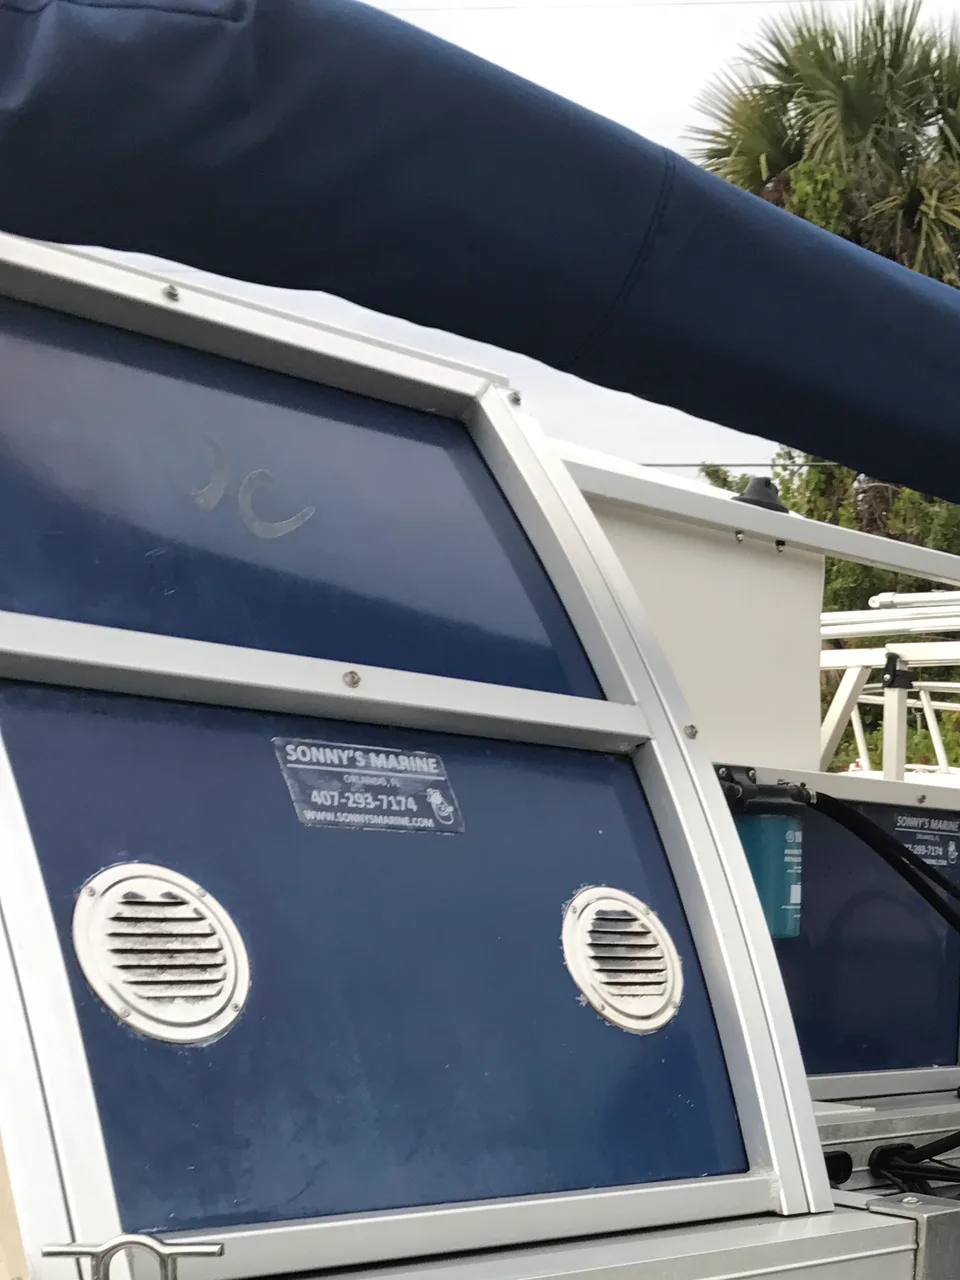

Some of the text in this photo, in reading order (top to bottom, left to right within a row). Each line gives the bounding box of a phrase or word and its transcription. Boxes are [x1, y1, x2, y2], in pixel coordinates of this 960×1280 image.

[285, 744, 440, 774] SONNY'S MARINE
[310, 789, 418, 812] 407-293-7174
[896, 815, 960, 831] SONNY'S MARINE
